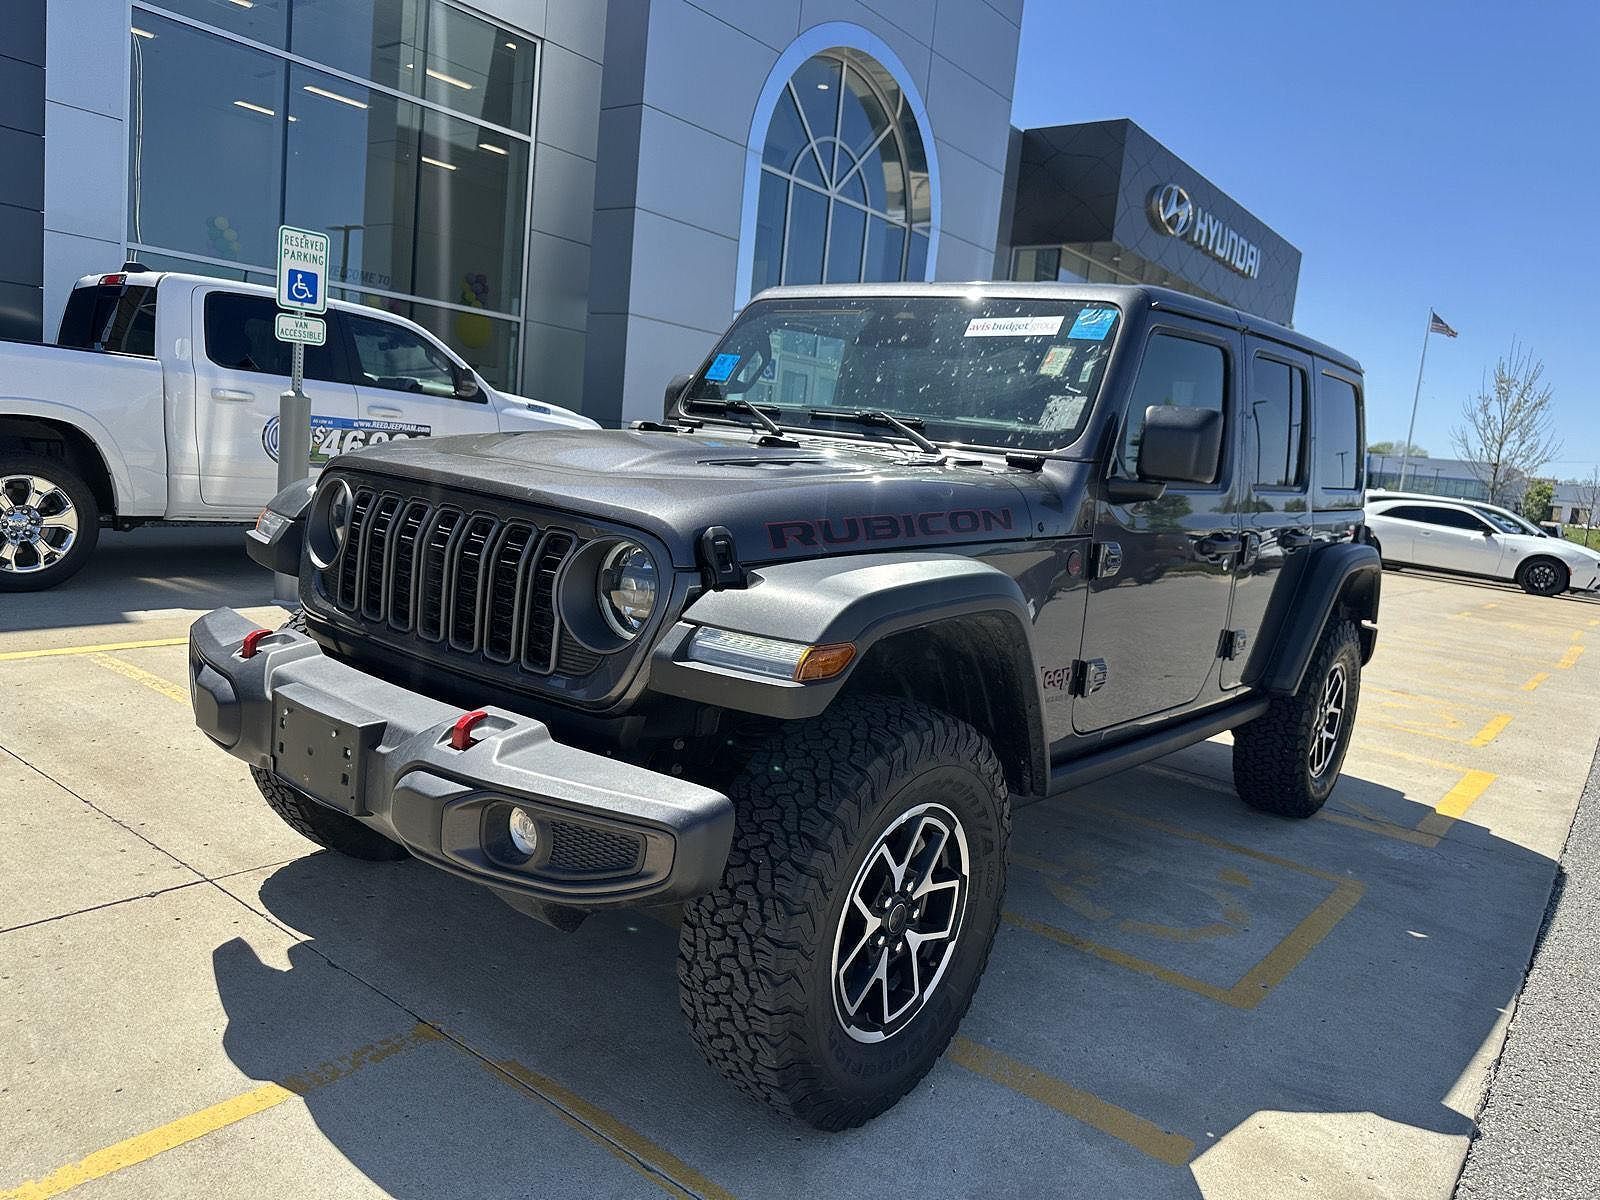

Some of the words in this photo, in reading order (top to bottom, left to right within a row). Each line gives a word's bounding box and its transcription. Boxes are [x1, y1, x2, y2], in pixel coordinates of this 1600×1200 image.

[284, 235, 324, 252] RESERVED
[1193, 207, 1260, 280] HYUNDAI
[284, 249, 324, 266] PARKING
[378, 273, 391, 285] TO
[294, 320, 309, 329] VAN
[969, 323, 992, 331] avis
[992, 321, 1029, 333] budget
[280, 328, 322, 341] ACCESSIBLE
[764, 508, 1013, 550] RUBICON
